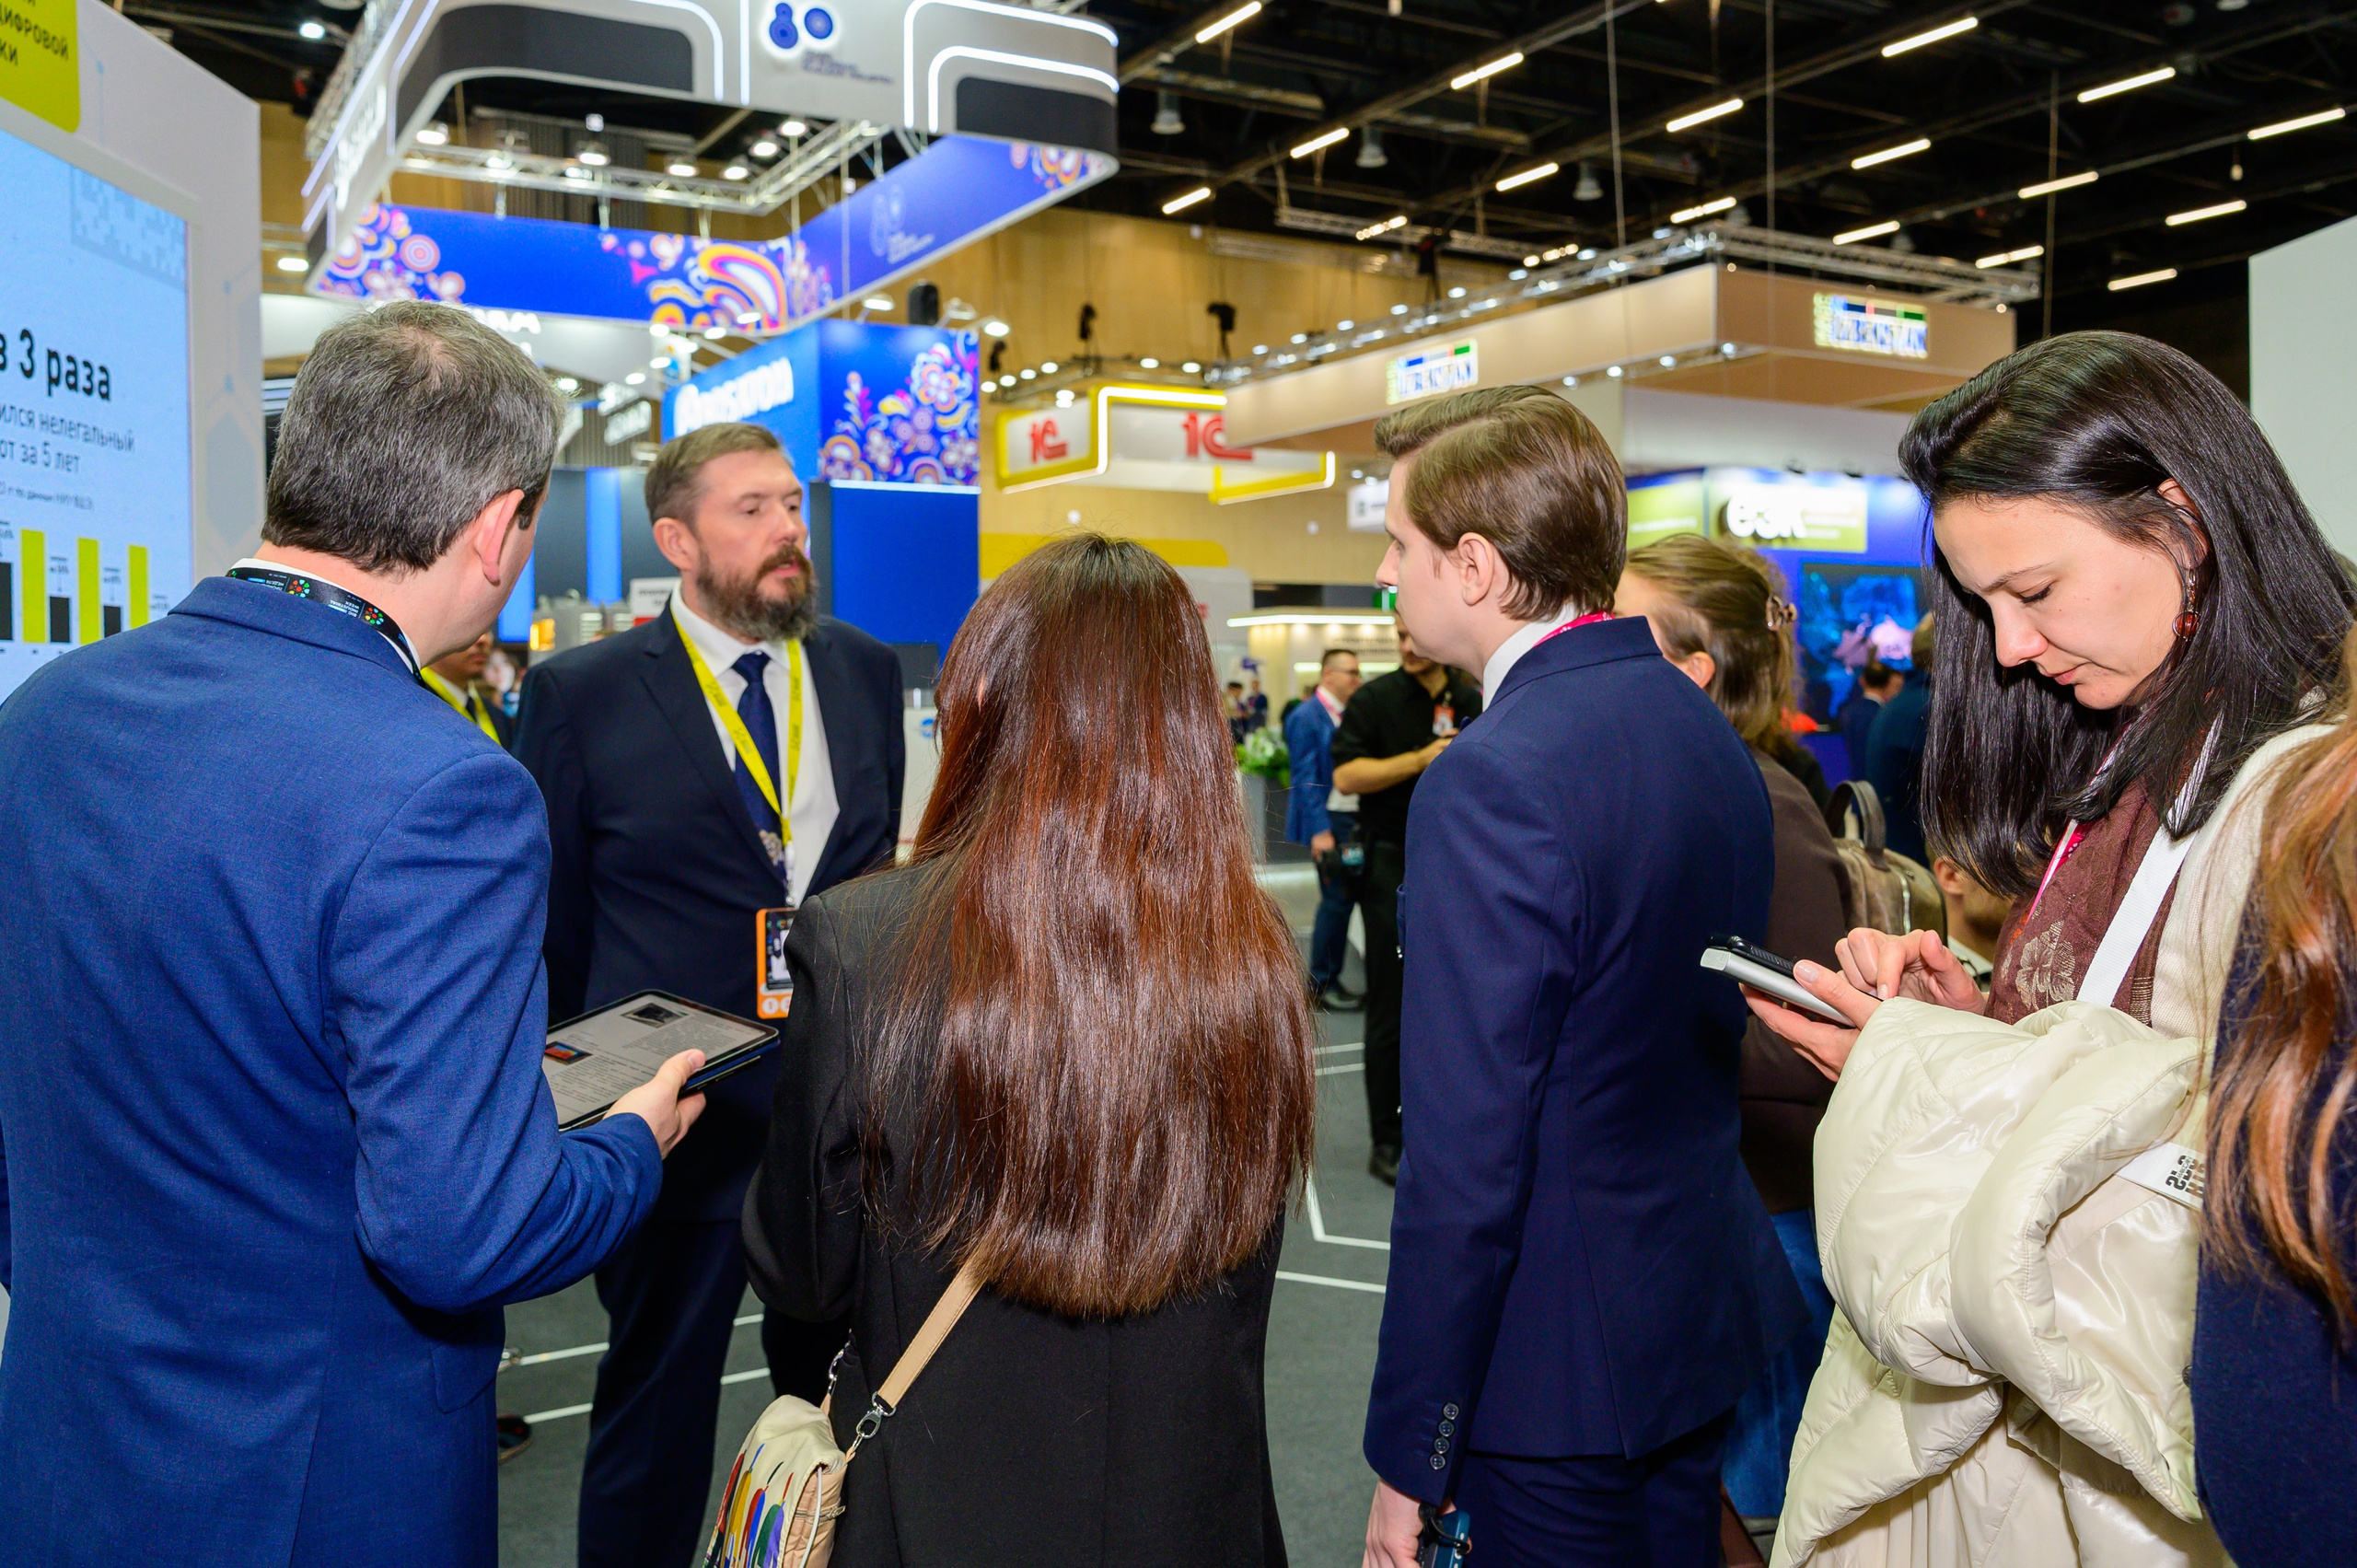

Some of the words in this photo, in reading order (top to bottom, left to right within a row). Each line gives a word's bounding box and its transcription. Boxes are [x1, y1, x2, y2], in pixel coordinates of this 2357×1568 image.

[19, 329, 34, 378] 3
[47, 349, 110, 401] раза
[39, 412, 135, 453] нелегальный
[21, 444, 38, 464] за
[42, 441, 51, 467] 5
[55, 451, 80, 472] лет
[330, 599, 359, 614] INDUSTRIAL
[345, 600, 360, 610] WEEK
